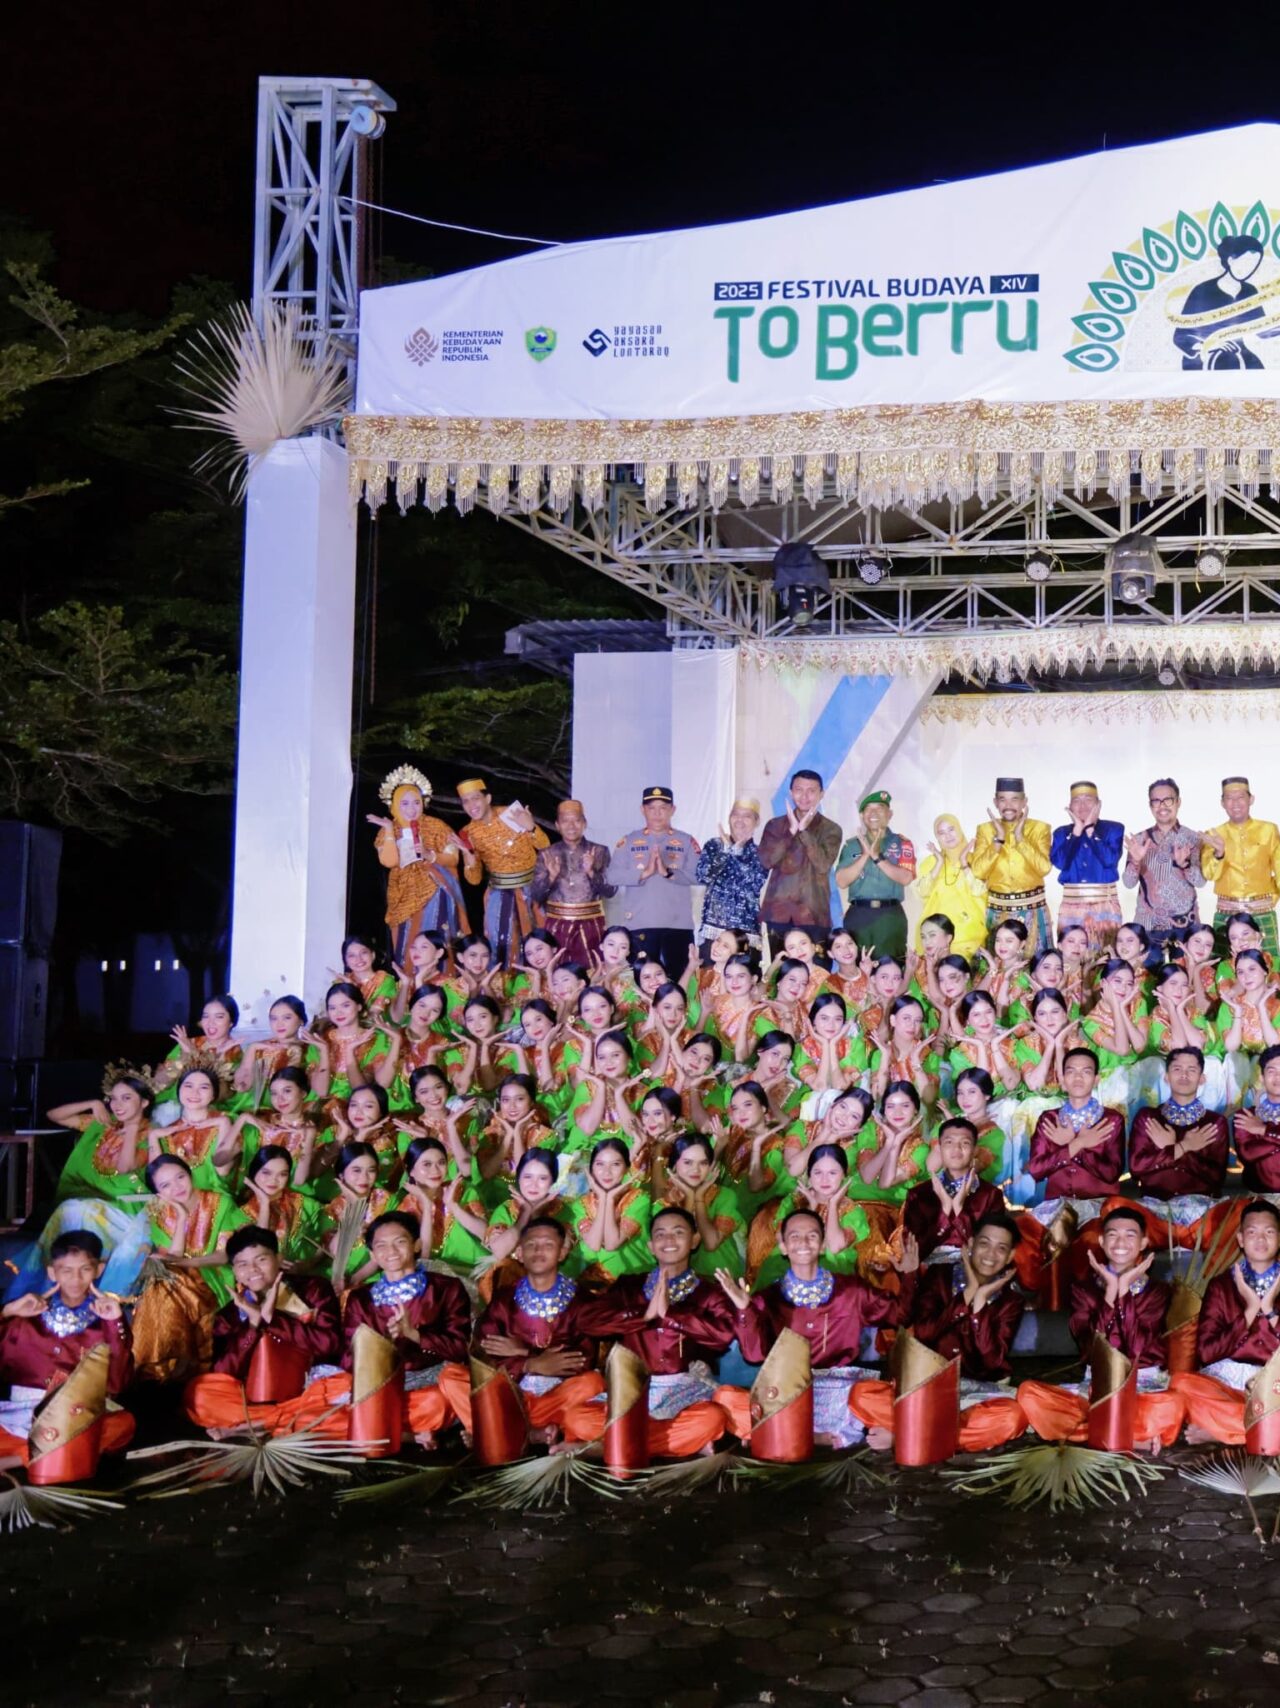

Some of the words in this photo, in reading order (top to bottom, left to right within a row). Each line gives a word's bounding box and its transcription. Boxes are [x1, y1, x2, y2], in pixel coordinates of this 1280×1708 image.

[717, 283, 759, 299] 2025
[769, 280, 880, 299] FESTIVAL
[887, 276, 985, 297] BUDAYA
[1001, 276, 1029, 290] XIV
[442, 330, 504, 339] KEMENTERIAN
[442, 338, 502, 346] KEBUDAYAAN
[815, 299, 1039, 381] Berru
[442, 346, 483, 354] REPUBLIK
[441, 354, 490, 362] INDONESIA
